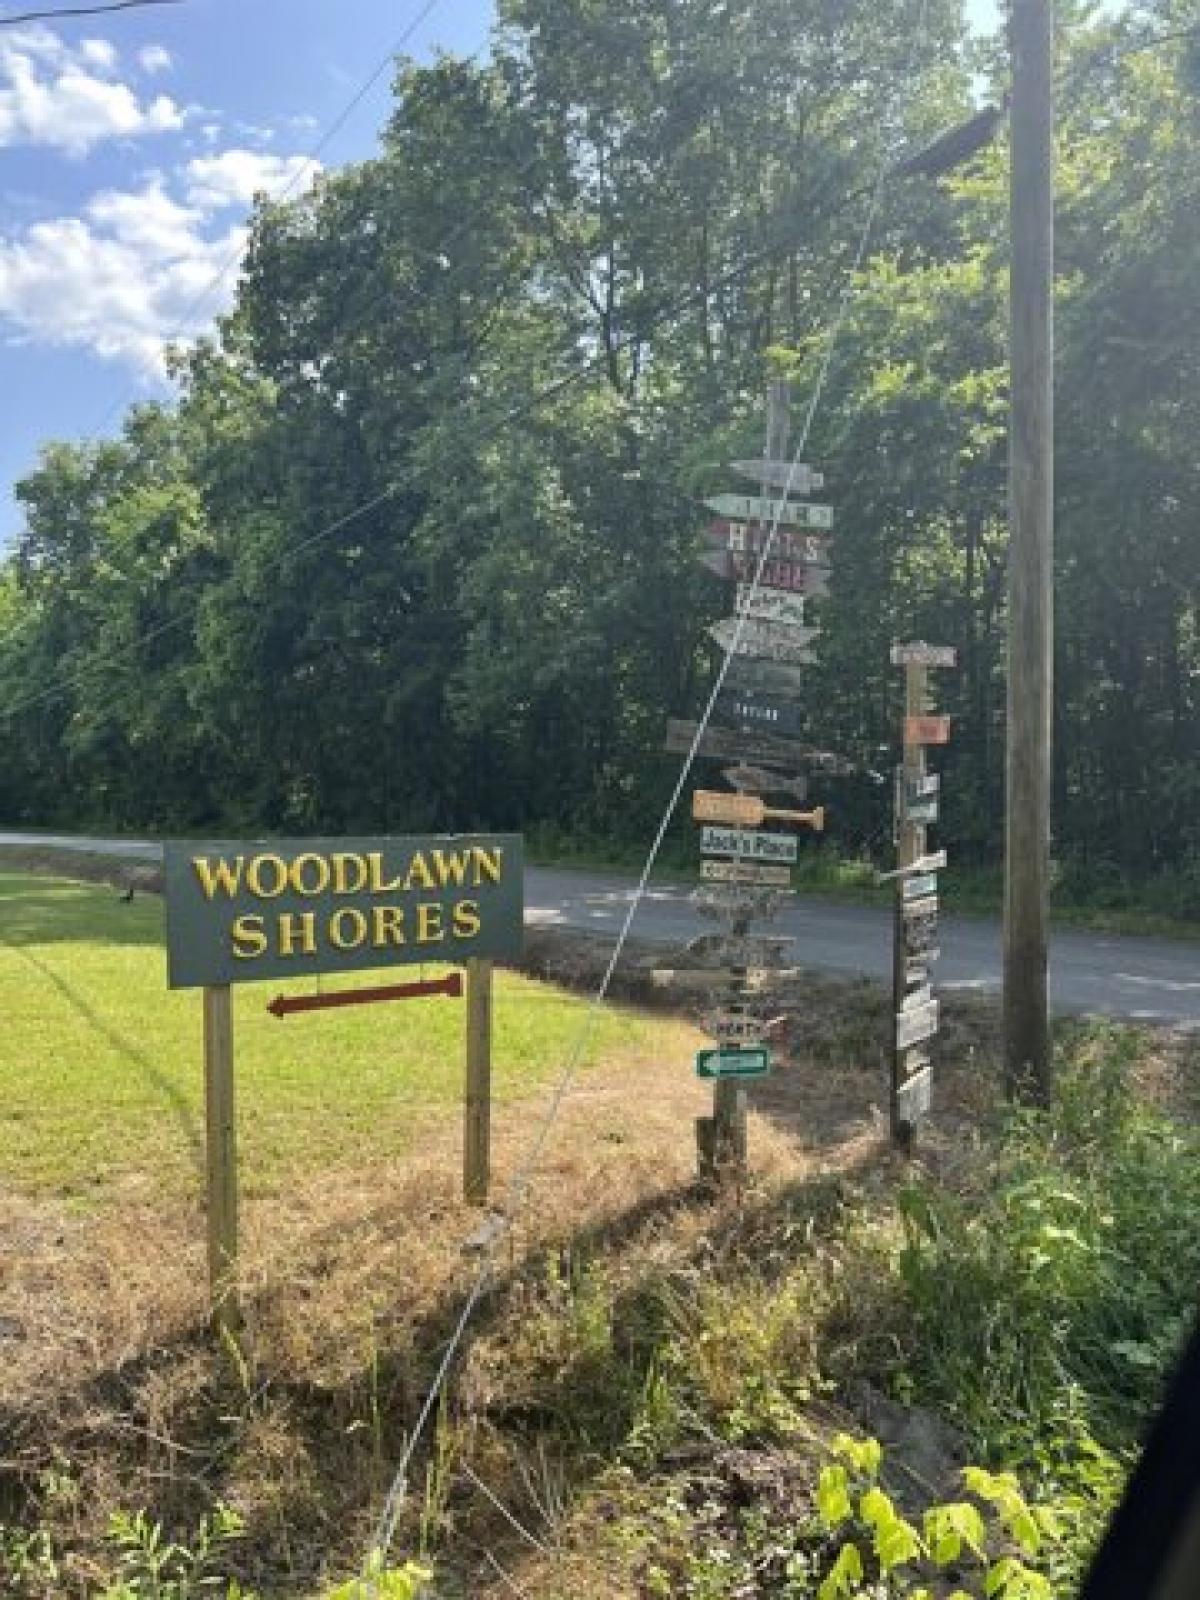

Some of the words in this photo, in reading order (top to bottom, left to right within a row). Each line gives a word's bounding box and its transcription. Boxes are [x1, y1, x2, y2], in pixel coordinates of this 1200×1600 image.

[703, 830, 751, 853] Jack's
[192, 846, 504, 900] WOODLAWN
[231, 898, 482, 960] SHORES
